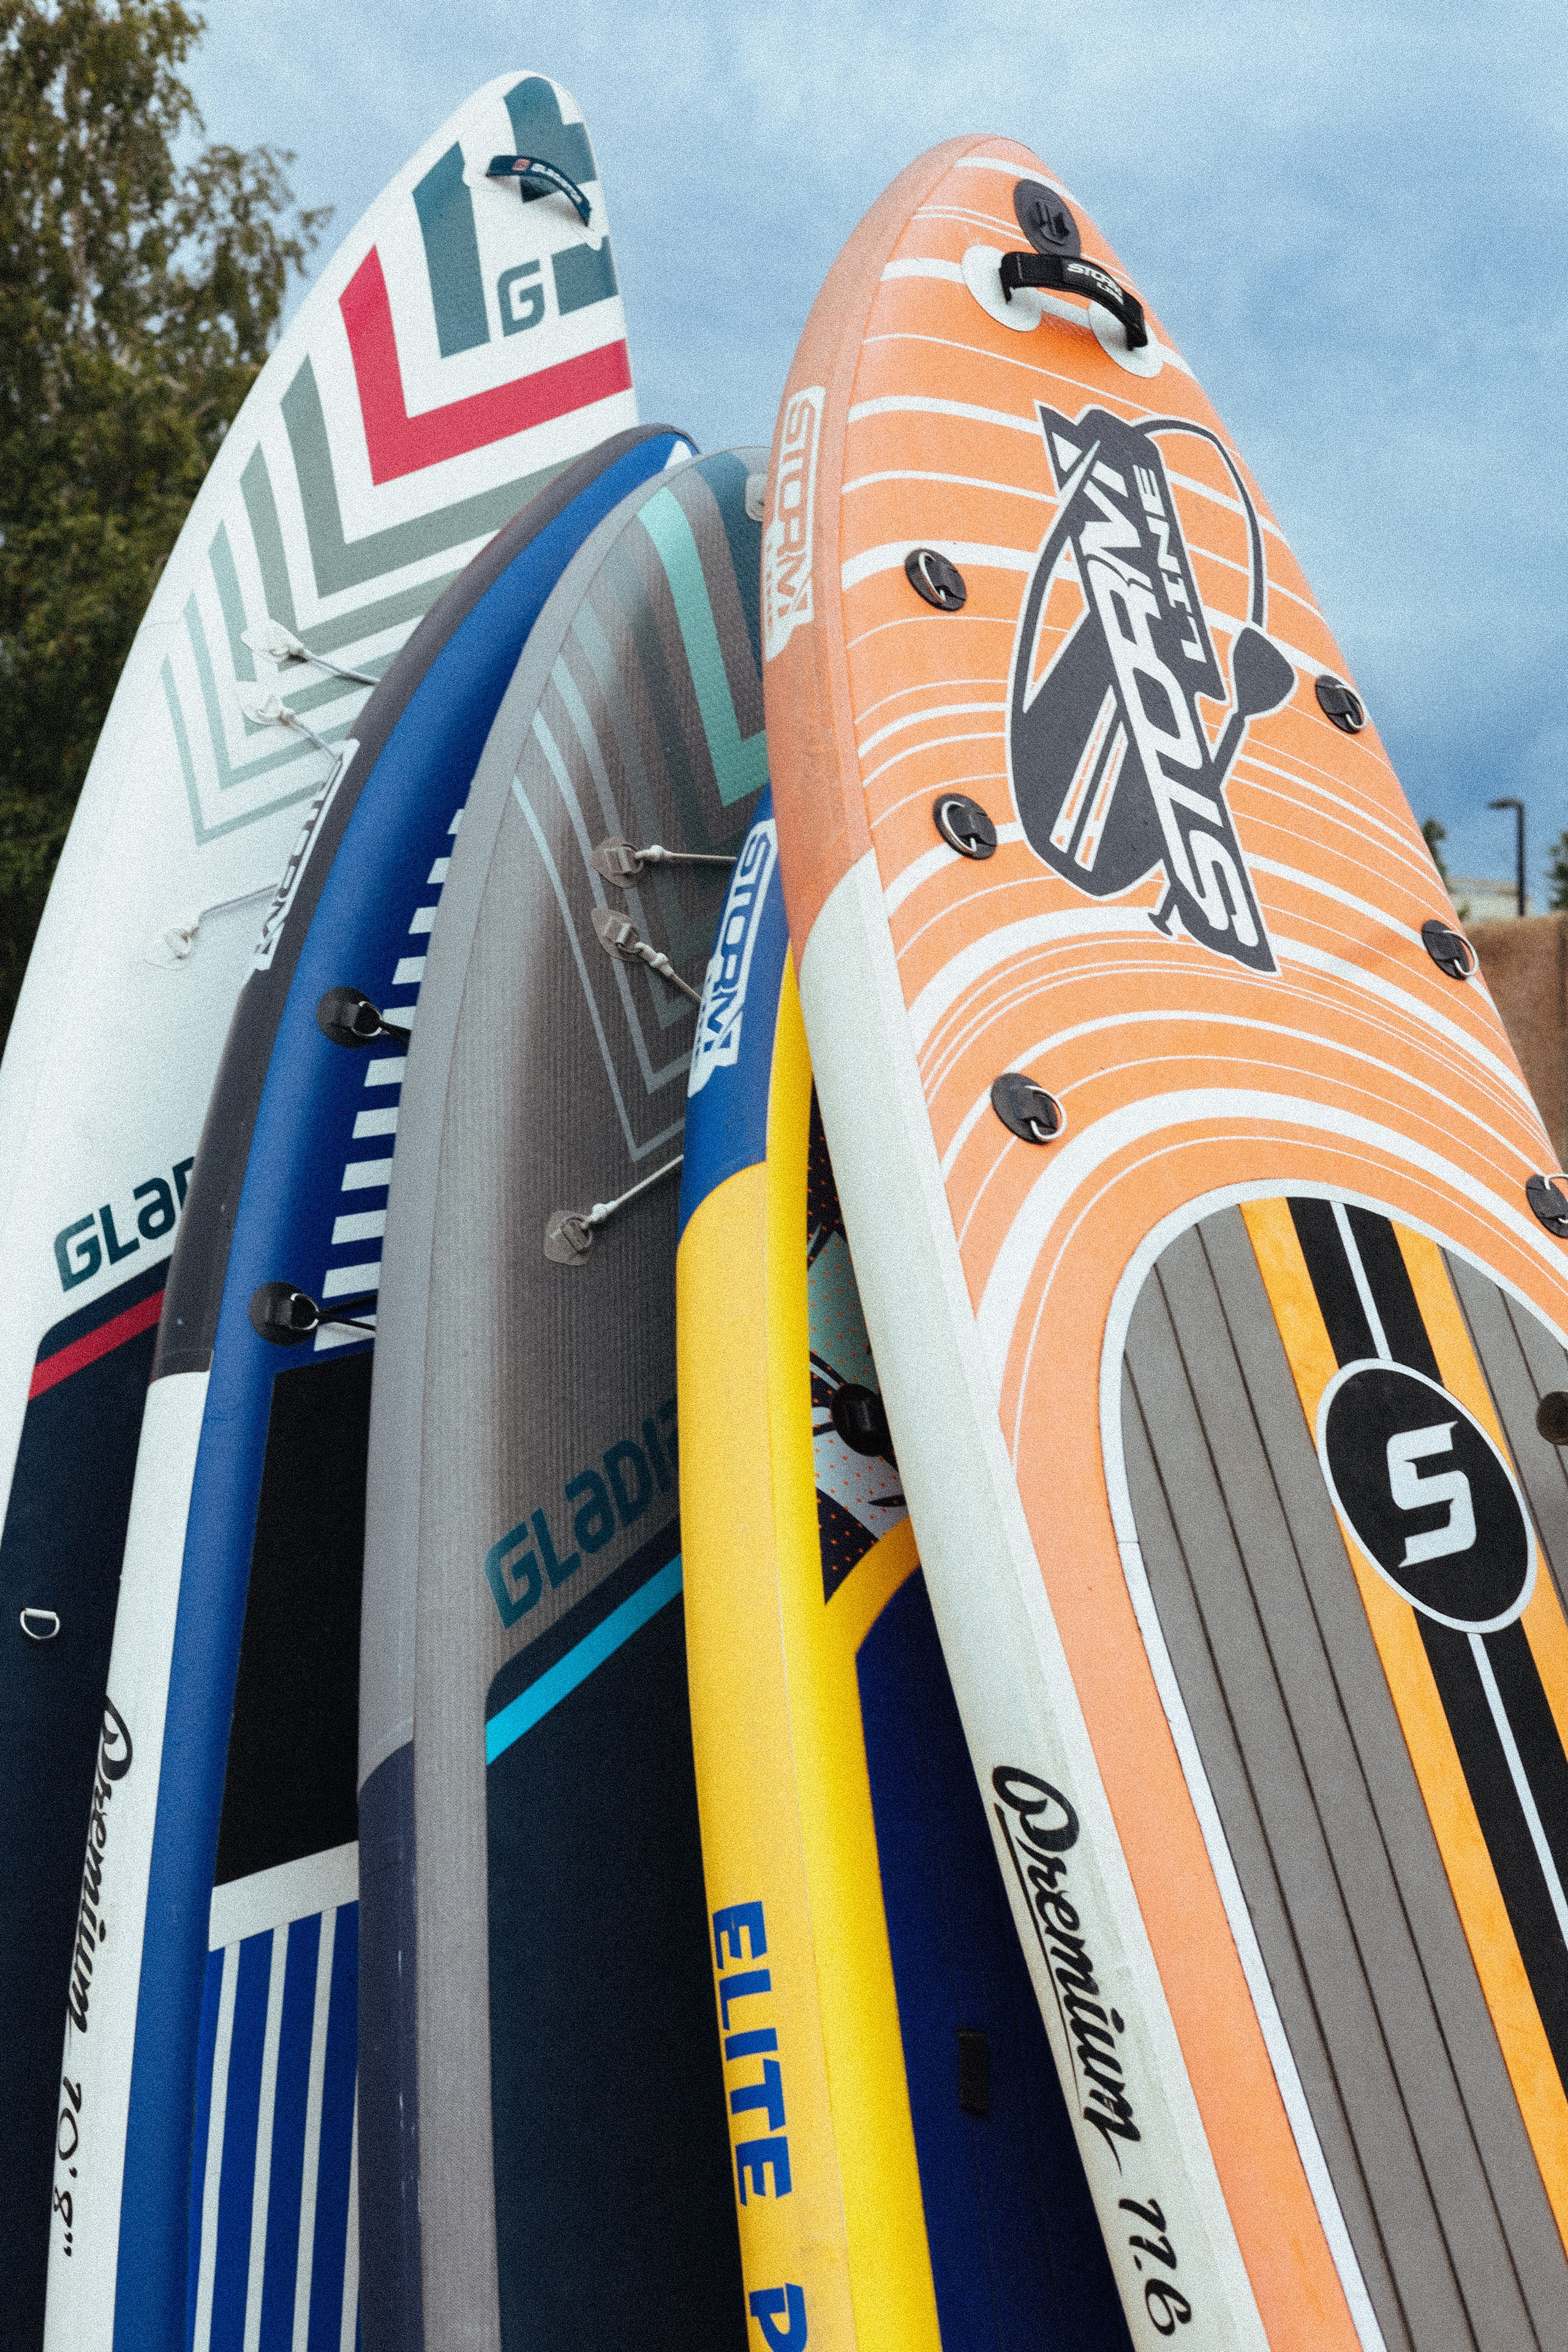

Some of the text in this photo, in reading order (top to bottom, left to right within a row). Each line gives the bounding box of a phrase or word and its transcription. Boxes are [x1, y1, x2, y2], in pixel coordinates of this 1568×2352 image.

[497, 258, 545, 337] G
[775, 399, 816, 619] STORM
[1133, 464, 1207, 664] LINE
[1051, 431, 1260, 948] STORM
[704, 832, 771, 1054] STORM
[1386, 1421, 1477, 1568] S
[69, 1695, 132, 2034] Premium
[992, 1765, 1142, 2174] Premium
[712, 1901, 793, 2207] ELITE
